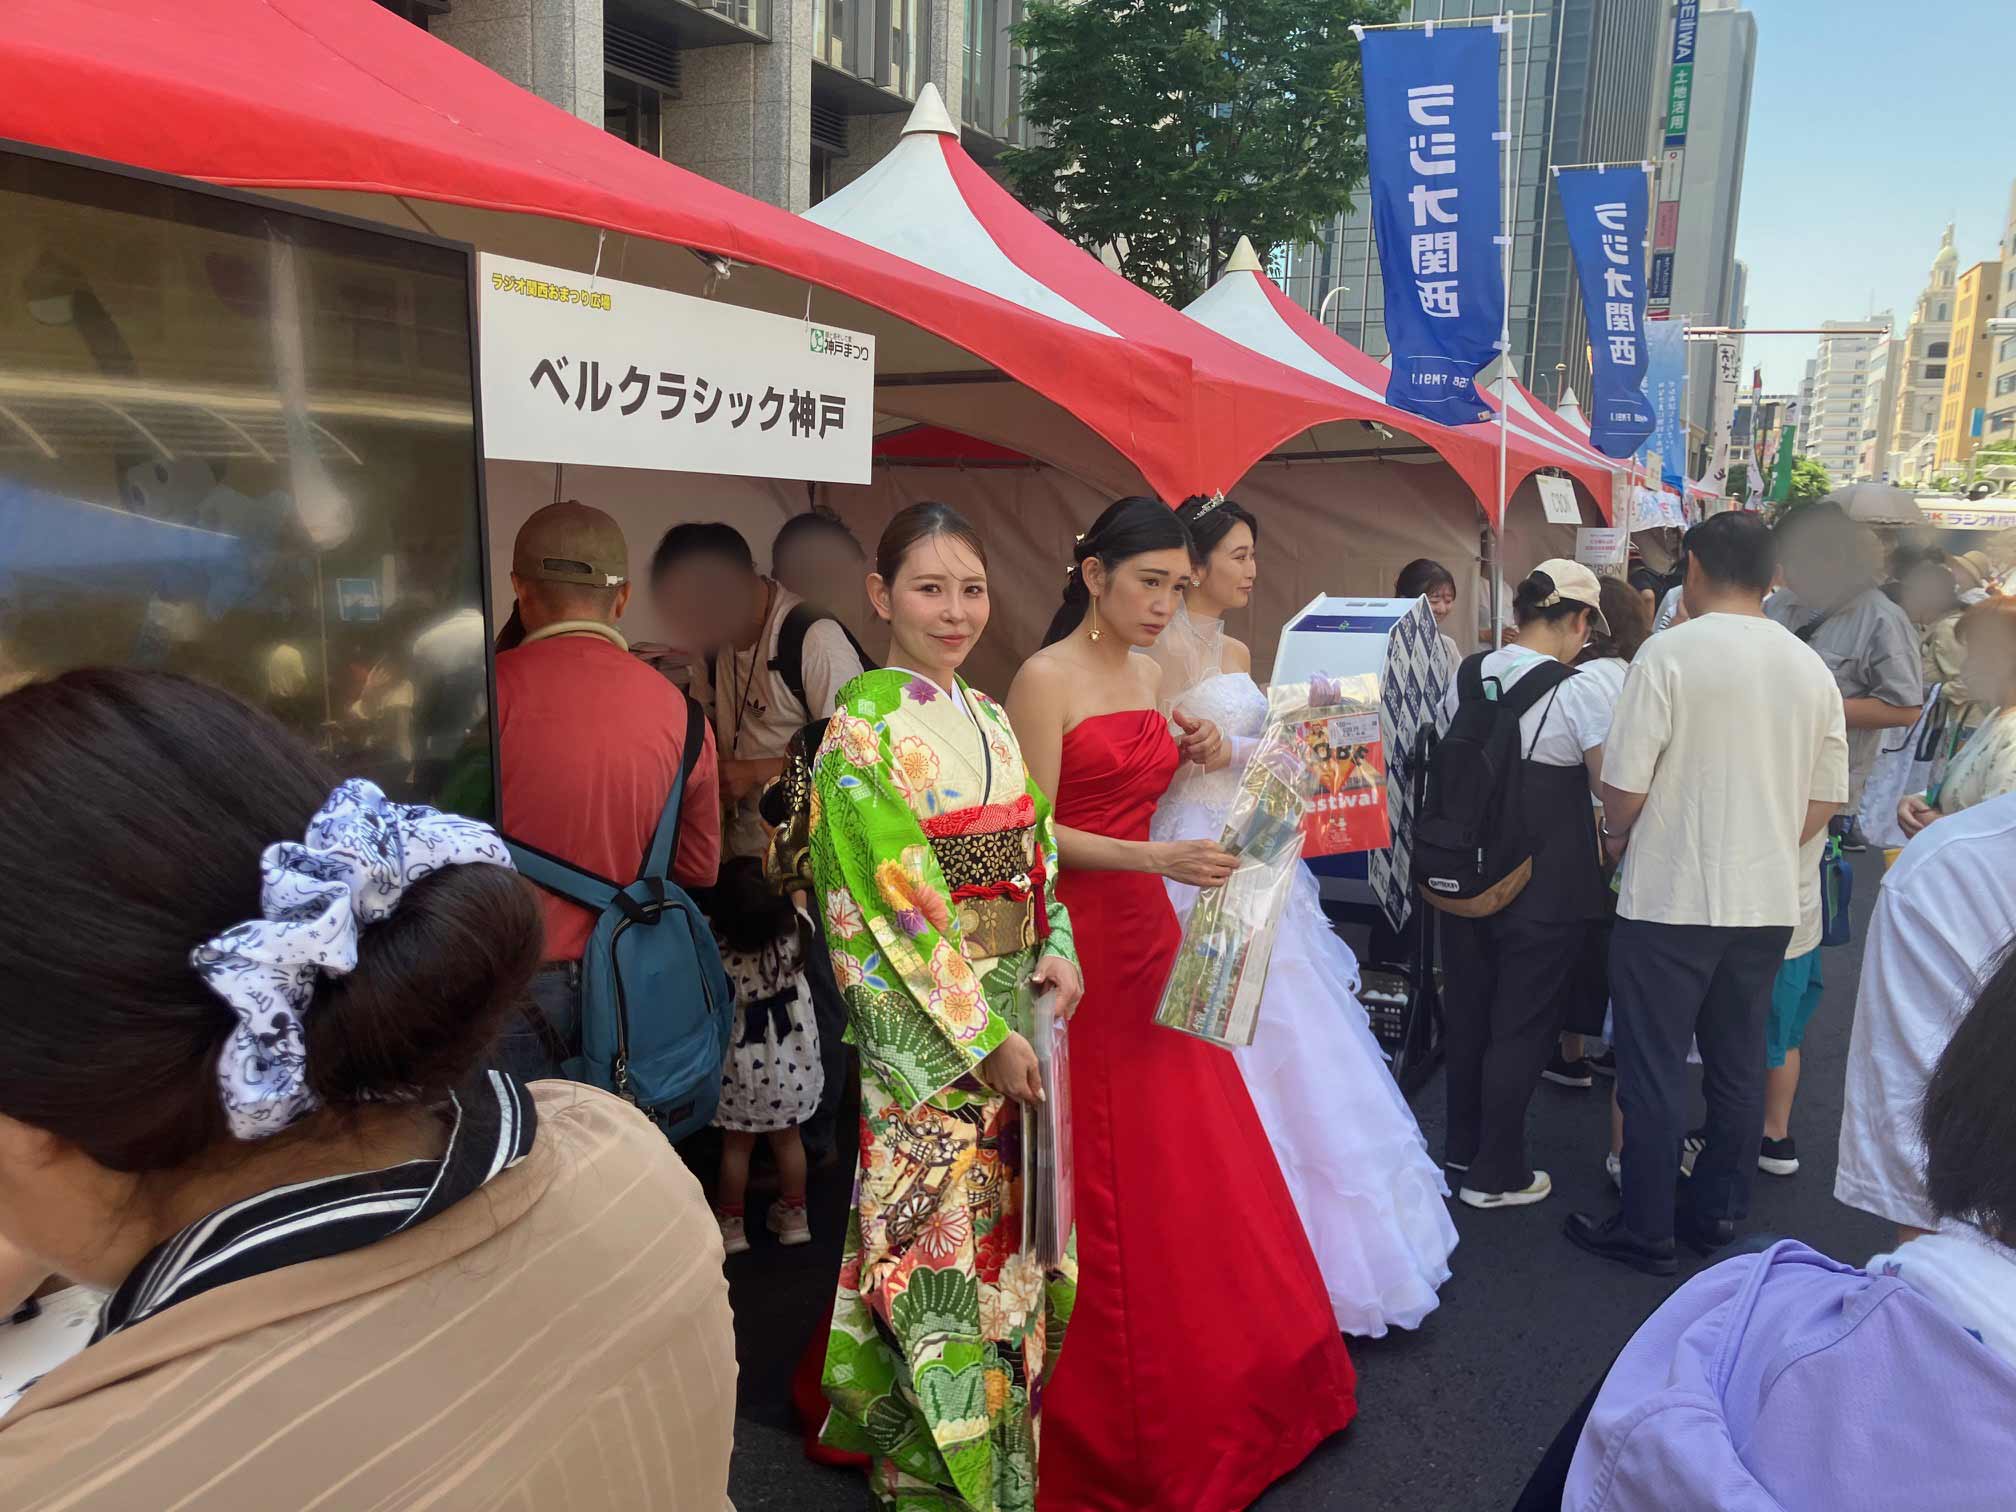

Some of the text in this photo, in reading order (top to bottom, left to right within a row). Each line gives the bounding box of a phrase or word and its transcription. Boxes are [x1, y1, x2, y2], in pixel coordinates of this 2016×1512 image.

[492, 272, 612, 311] ラジオ関西おまつり広場
[824, 339, 869, 361] 神戸まつり
[529, 355, 847, 440] ベルクラシック神戸
[1303, 789, 1379, 813] estival
